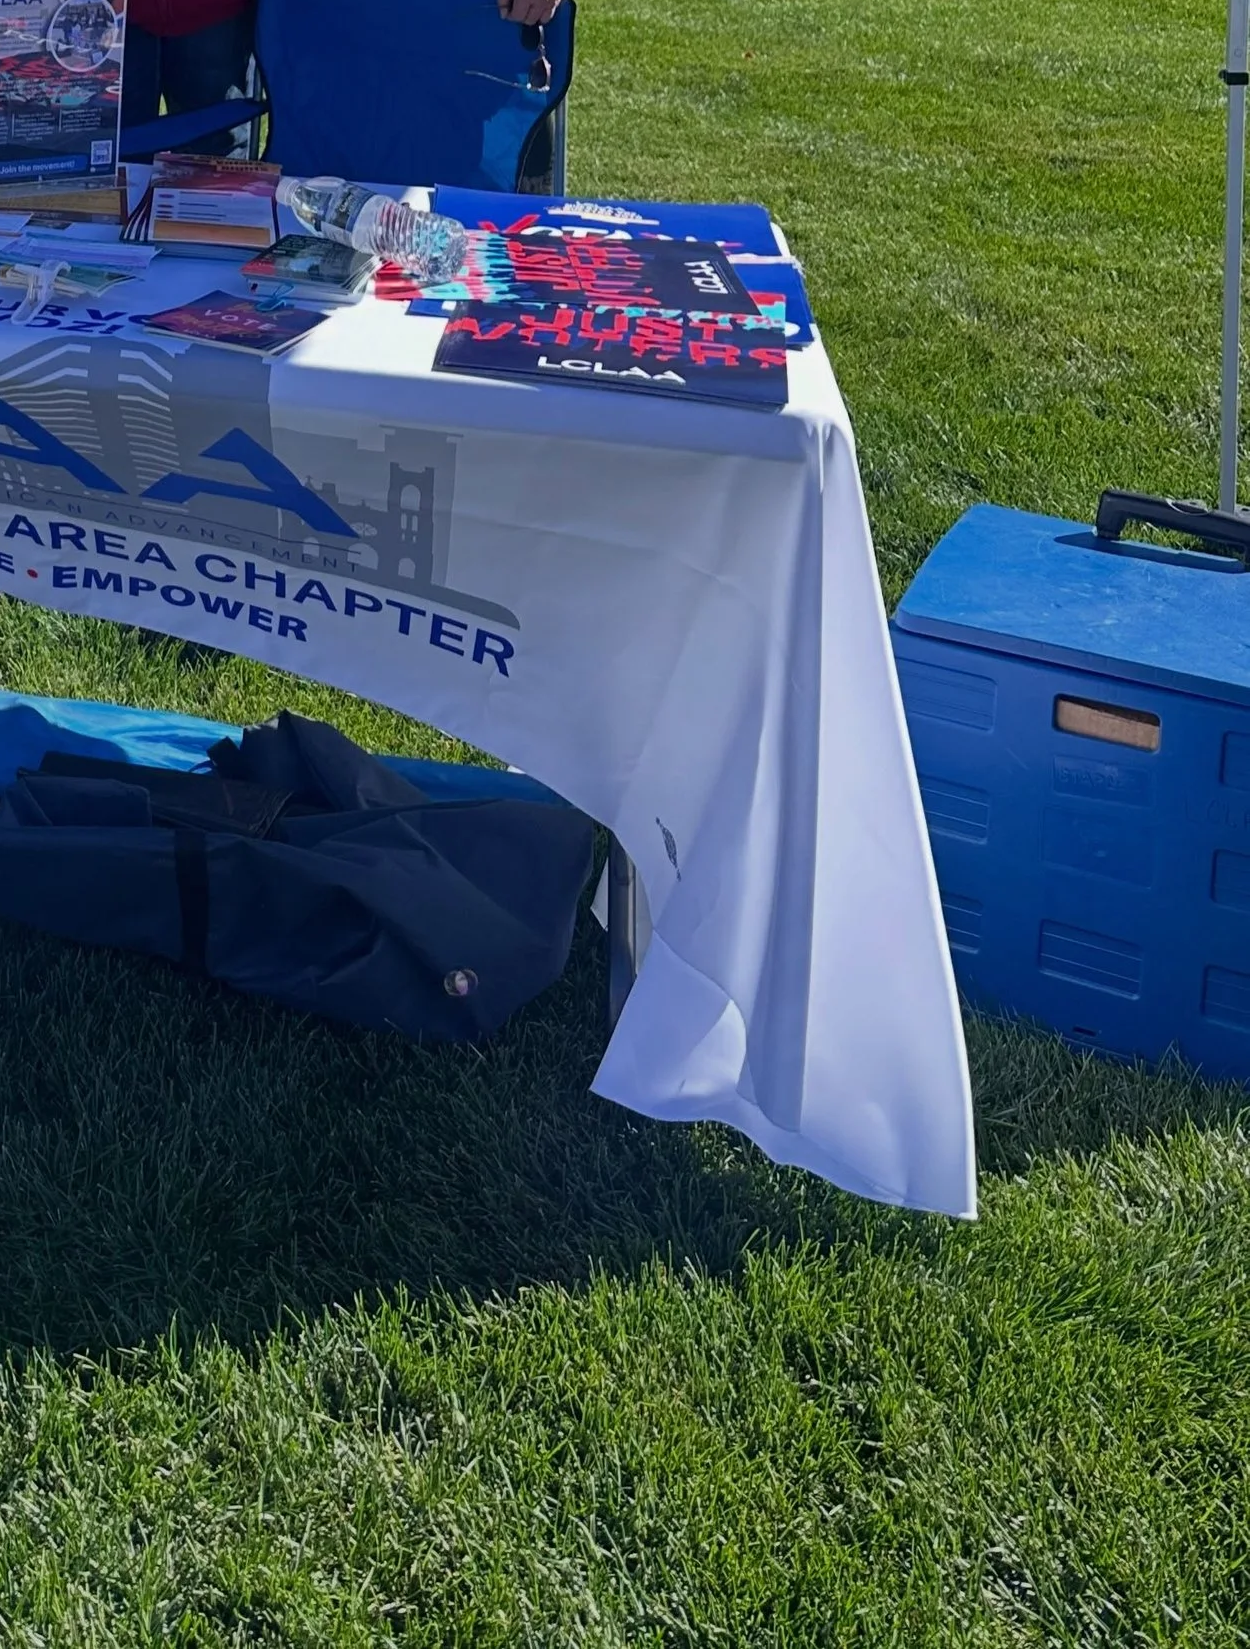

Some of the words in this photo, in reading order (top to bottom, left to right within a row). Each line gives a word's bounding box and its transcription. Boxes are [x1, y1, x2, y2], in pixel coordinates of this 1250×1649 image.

[0, 165, 17, 175] Join
[17, 164, 31, 173] the
[32, 159, 76, 171] movement!
[204, 309, 277, 331] VOTE
[538, 355, 686, 386] LCLAA
[105, 510, 358, 574] ADVANCEMENT
[4, 513, 178, 572] AREA
[195, 552, 516, 679] CHAPTER
[52, 565, 309, 643] EMPOWER
